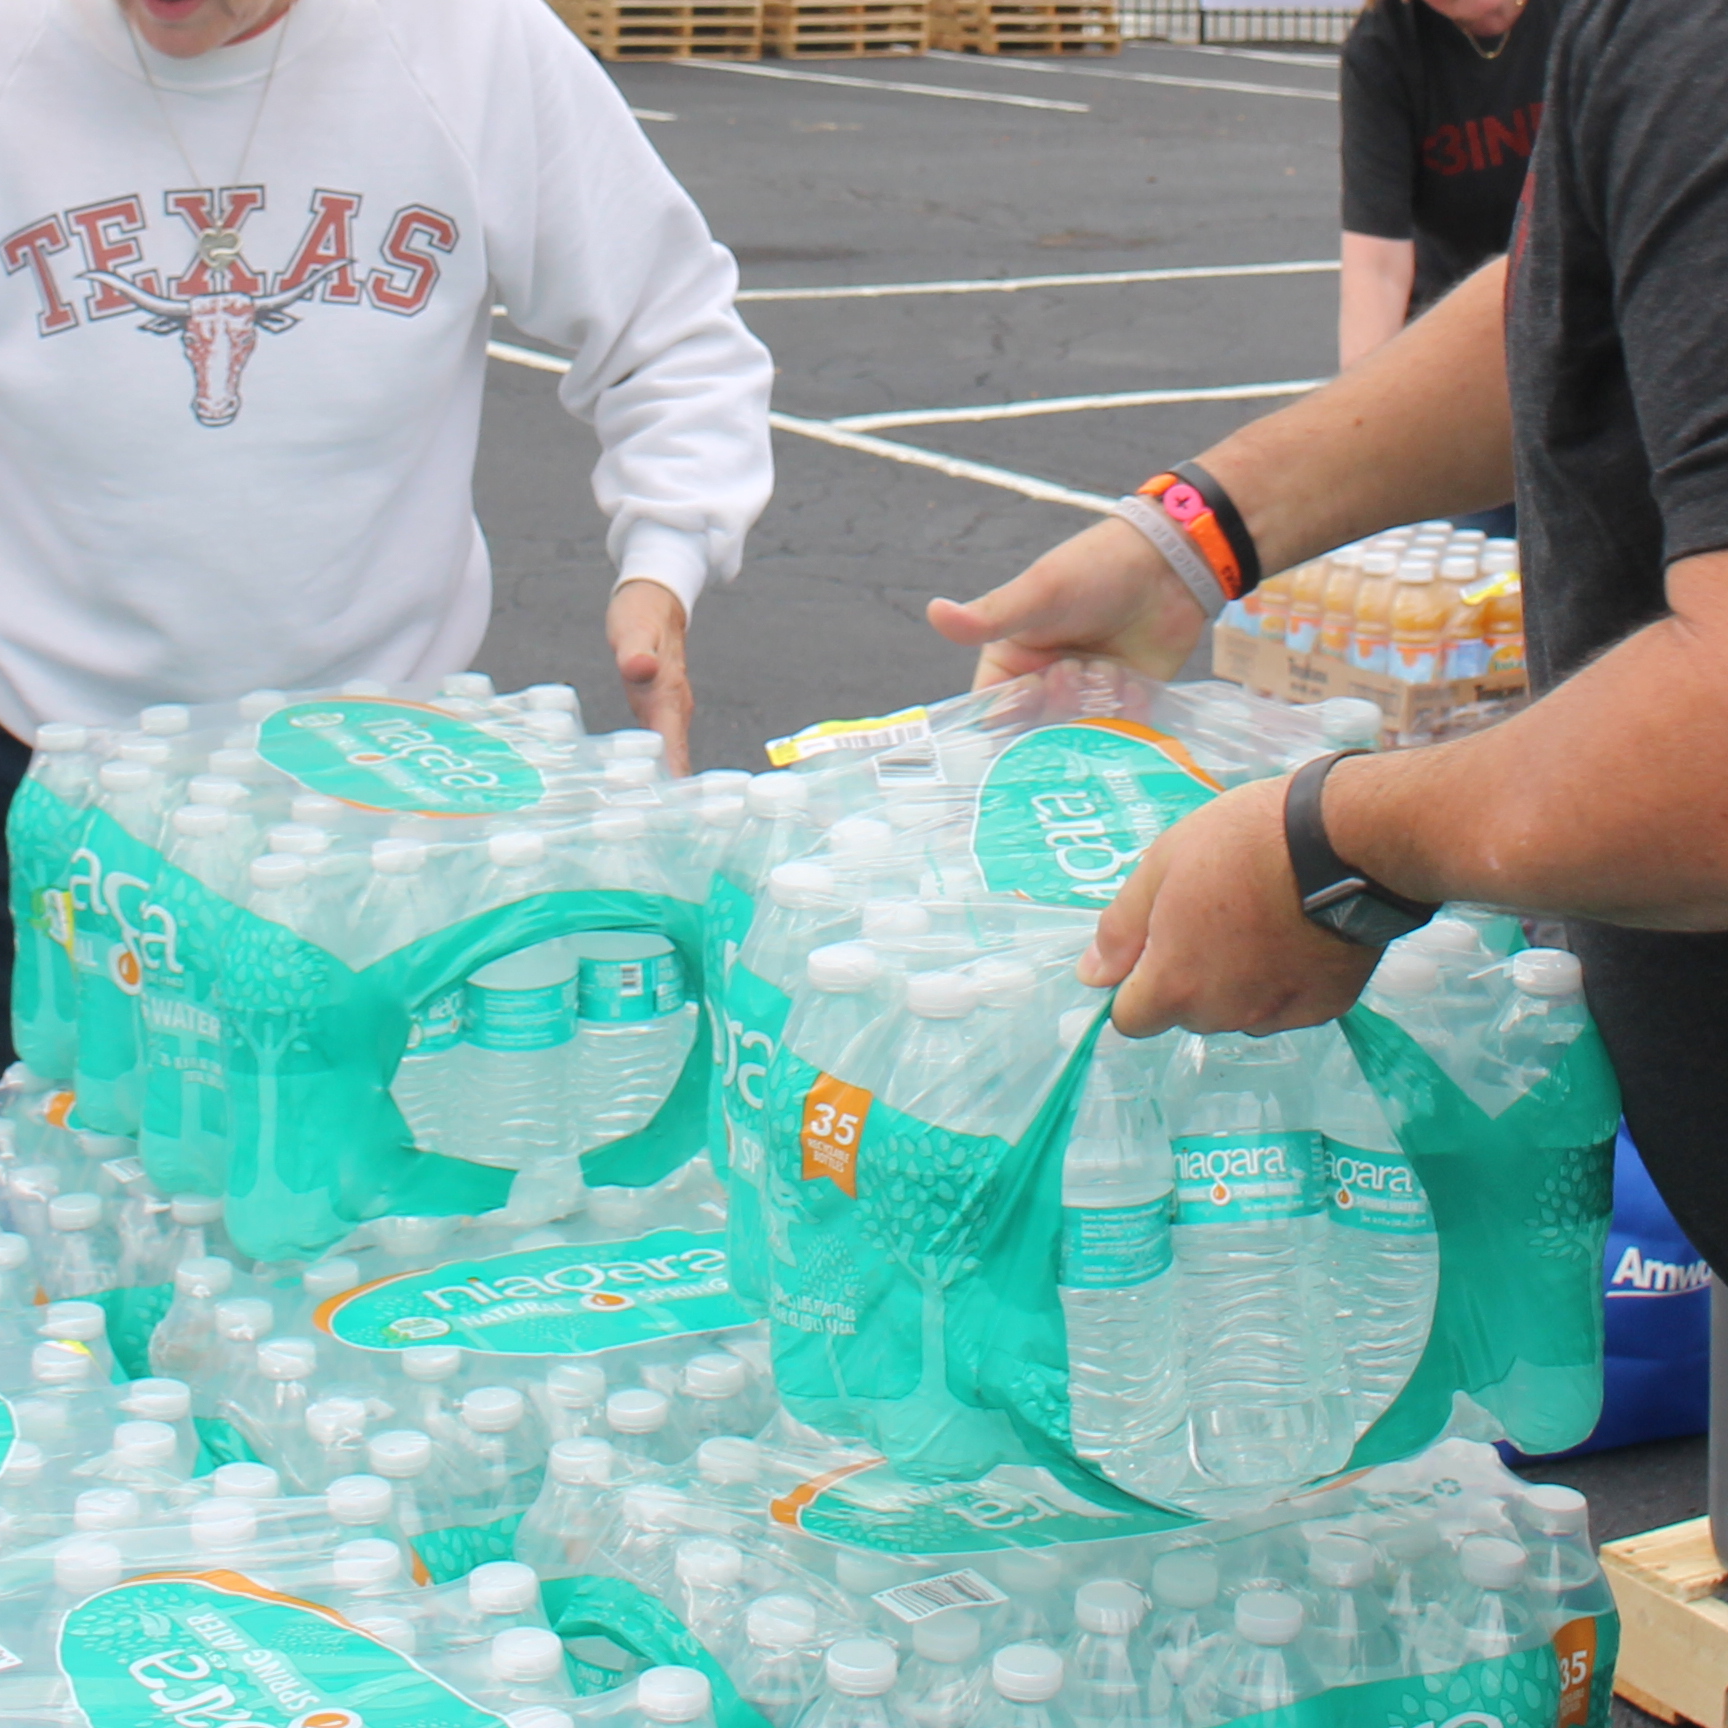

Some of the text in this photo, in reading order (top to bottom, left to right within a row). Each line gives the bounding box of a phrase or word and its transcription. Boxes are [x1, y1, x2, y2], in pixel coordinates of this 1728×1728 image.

[150, 1001, 222, 1039] WATER
[810, 1102, 860, 1146] 35
[1173, 1145, 1286, 1185] niagara
[421, 1246, 728, 1312] niagara
[459, 1276, 731, 1332] NATURAL SPRING
[239, 1650, 322, 1711] SPRING
